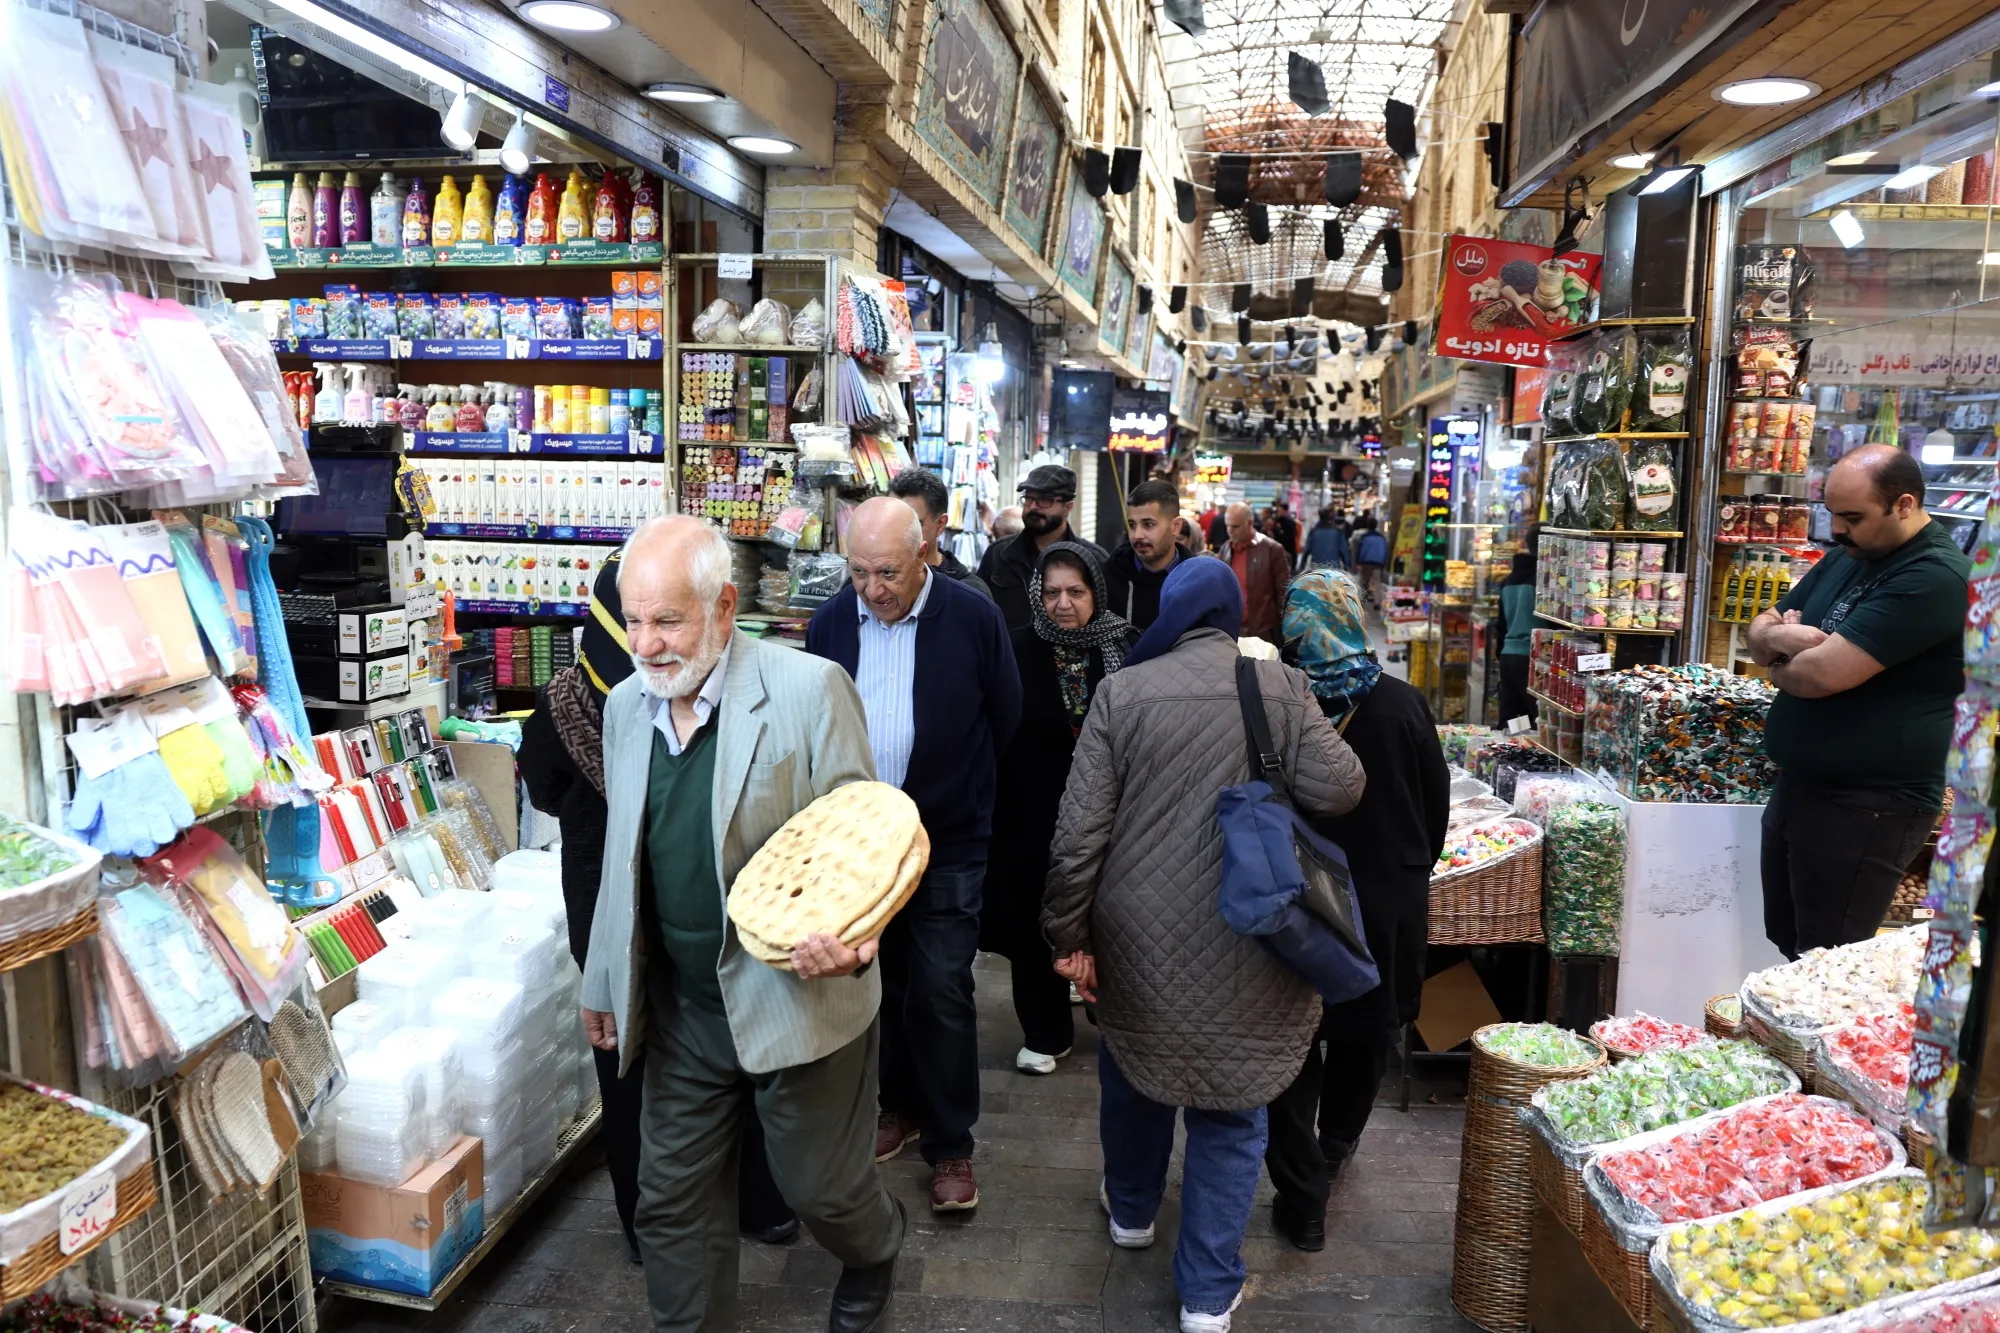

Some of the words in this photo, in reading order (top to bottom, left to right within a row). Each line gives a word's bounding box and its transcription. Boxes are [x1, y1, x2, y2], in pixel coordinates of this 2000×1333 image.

[1456, 250, 1484, 266] ملل
[1743, 263, 1791, 278] Alicafé
[327, 292, 345, 302] Bref
[371, 300, 389, 308] Bref
[406, 300, 424, 308] Bref
[440, 299, 460, 308] Bref
[471, 299, 489, 308] Bref
[541, 304, 562, 313] Bref
[587, 303, 608, 314] Bref
[296, 305, 315, 315] Bref
[506, 304, 529, 314] Bref
[1750, 330, 1778, 339] BIKA
[311, 345, 338, 353] میسویک
[425, 345, 453, 353] میسویک
[543, 345, 571, 353] میسویک
[1446, 336, 1501, 355] ادویه
[1505, 342, 1539, 360] تازه
[1836, 360, 1850, 374] رم
[1860, 353, 1884, 374] گلس
[1892, 353, 1910, 374] قاب
[1920, 355, 1950, 374] جانبی
[1954, 353, 1982, 374] لوازم
[428, 437, 454, 445] میسویک
[544, 438, 573, 446] میسویک
